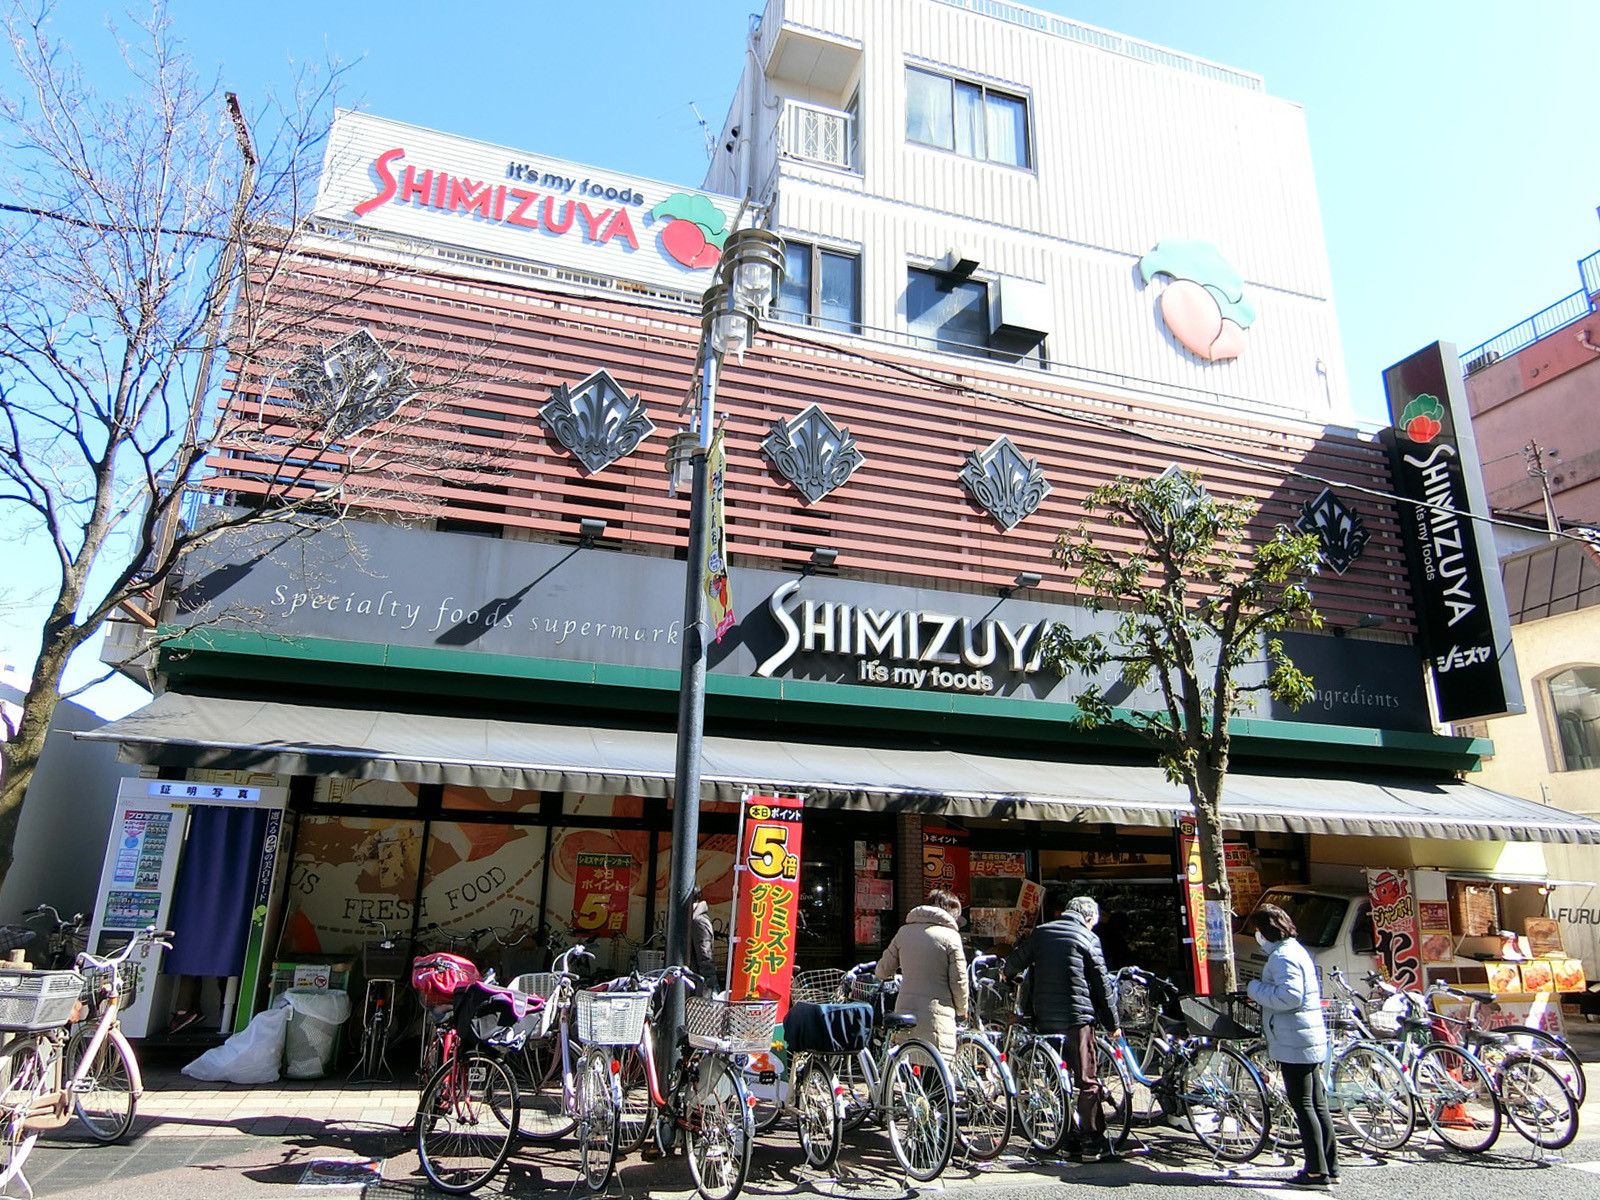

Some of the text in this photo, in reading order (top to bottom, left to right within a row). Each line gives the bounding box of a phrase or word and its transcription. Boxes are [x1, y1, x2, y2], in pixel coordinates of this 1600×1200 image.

[353, 147, 641, 251] SHIMIZUYA
[508, 160, 646, 207] it's my foods
[1403, 443, 1477, 628] SHIMIZUYA
[1418, 524, 1430, 541] my
[1421, 542, 1436, 582] foods
[270, 583, 421, 633] Specialty
[429, 596, 515, 633] foods
[529, 614, 683, 647] supermark
[858, 659, 994, 693] it's my foods
[1436, 644, 1491, 673] シミズヤ
[1310, 684, 1400, 711] ngredients
[159, 783, 249, 800] 証明写真
[751, 806, 802, 822] 本日ポイント
[748, 825, 799, 881] 5倍
[342, 865, 508, 921] FRESH FOOD
[593, 868, 615, 880] 本日
[577, 893, 625, 931] 5倍
[763, 884, 793, 974] シミズヤ
